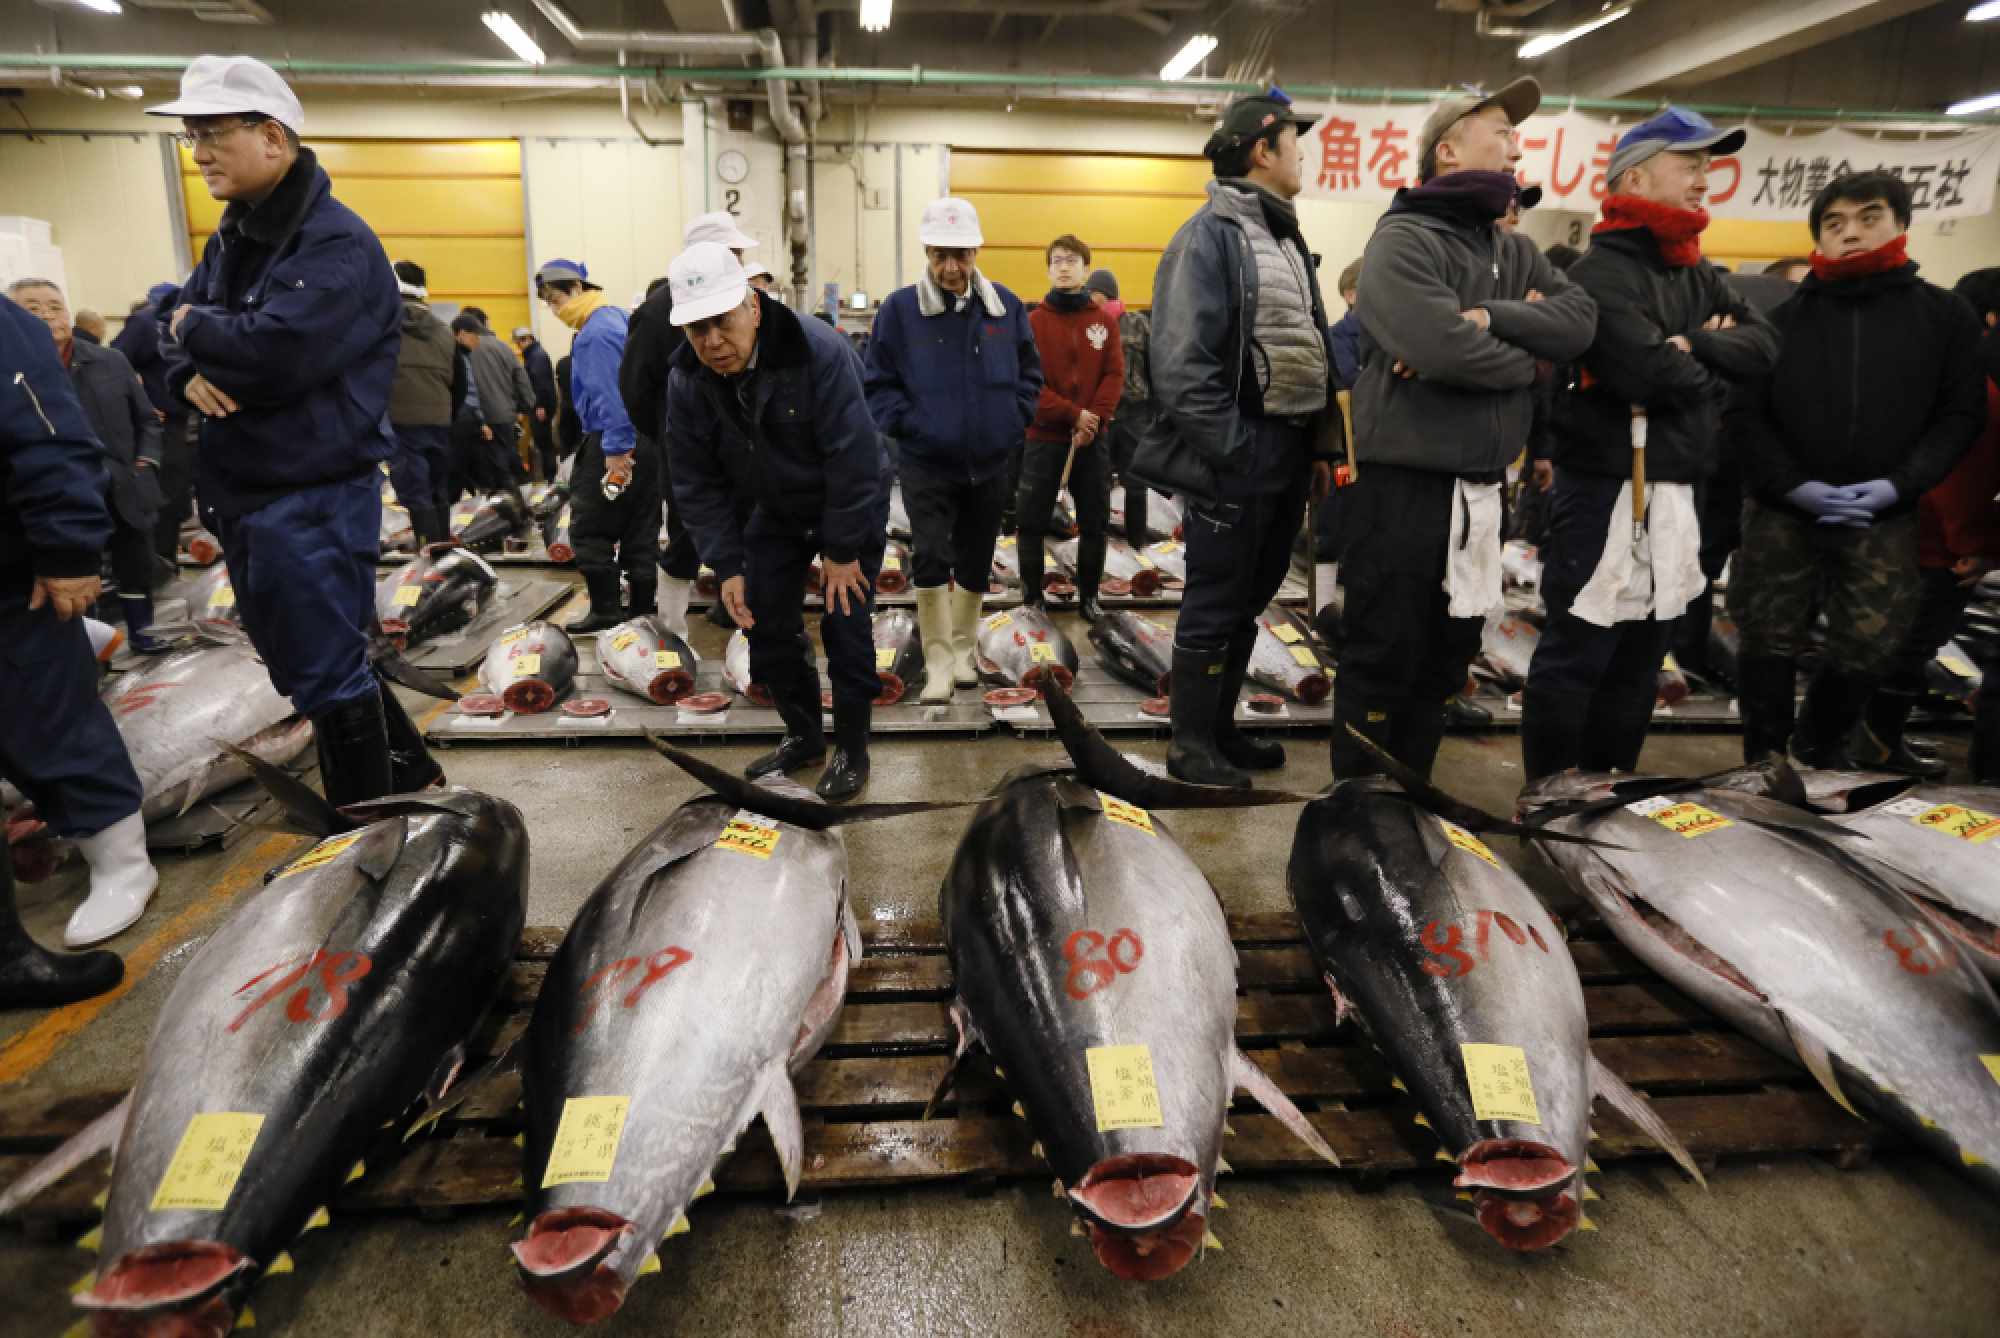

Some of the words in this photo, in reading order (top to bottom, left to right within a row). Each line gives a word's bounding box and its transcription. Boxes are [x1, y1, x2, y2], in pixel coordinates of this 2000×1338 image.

[725, 189, 740, 216] 2
[224, 948, 373, 1034] 78
[568, 945, 694, 1037] 79
[1062, 927, 1145, 1002] 80
